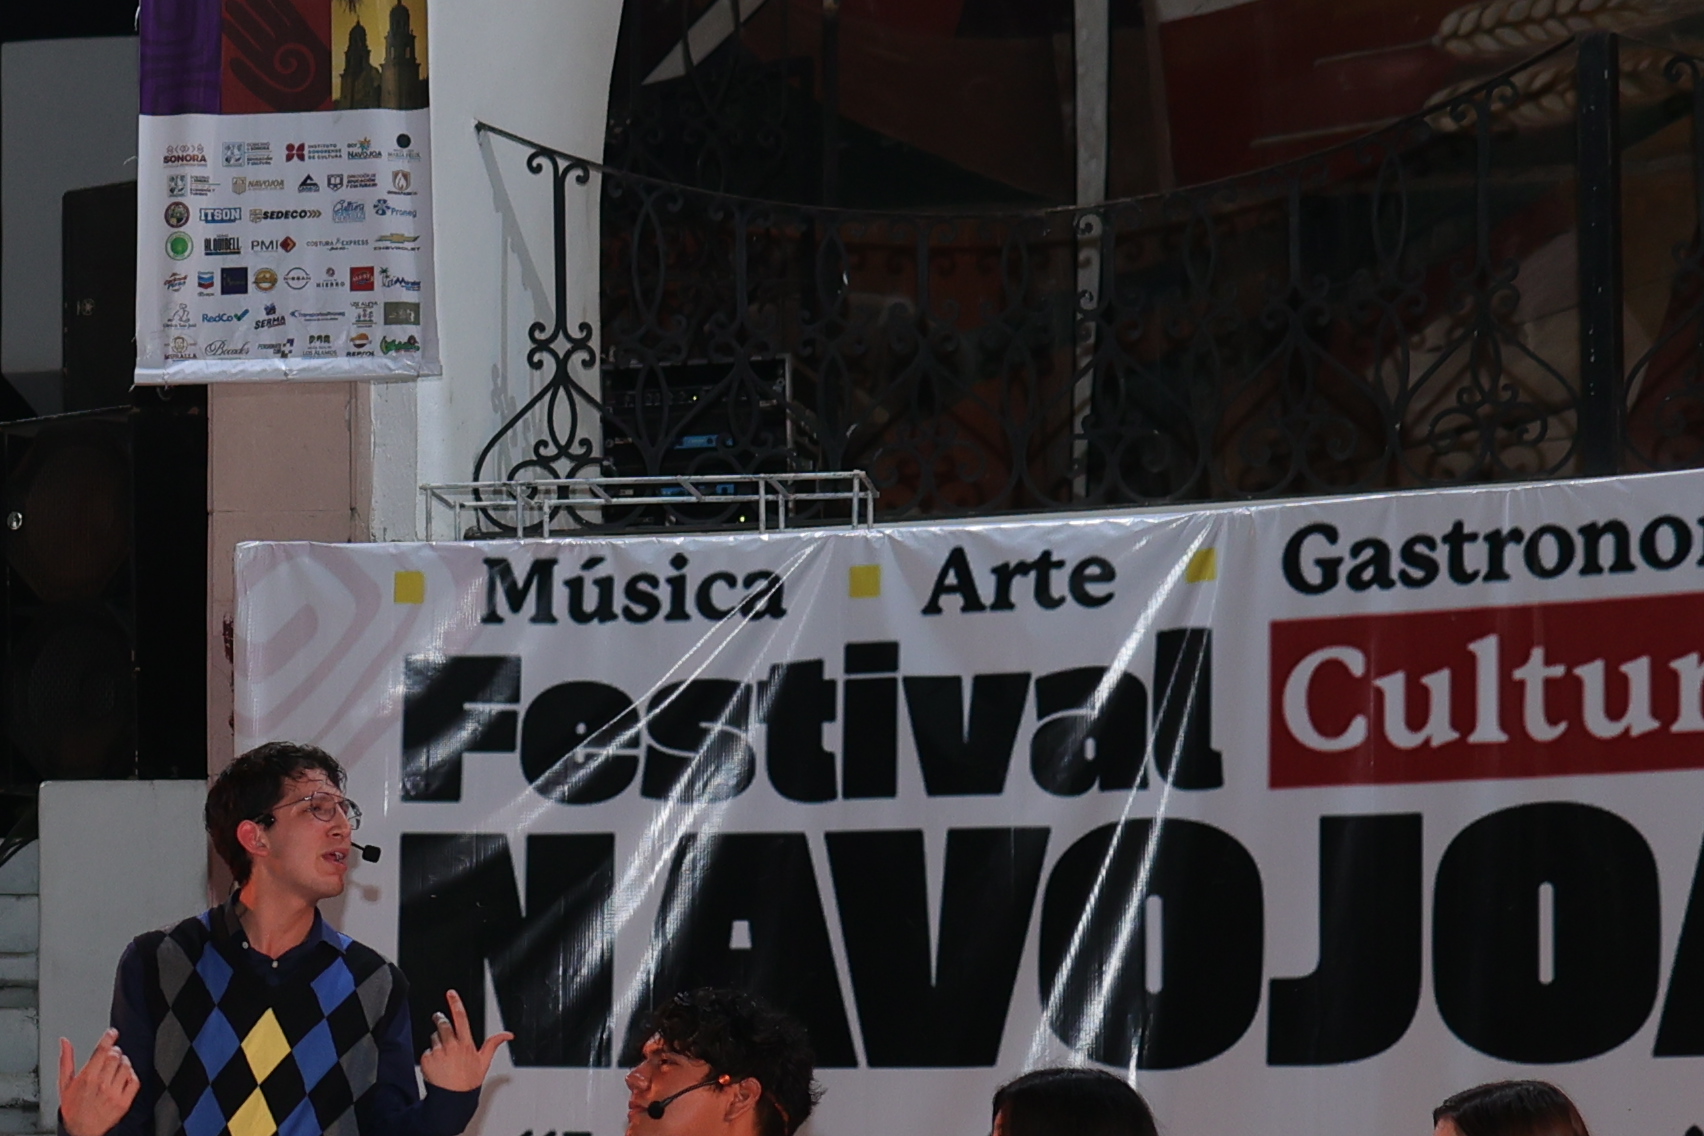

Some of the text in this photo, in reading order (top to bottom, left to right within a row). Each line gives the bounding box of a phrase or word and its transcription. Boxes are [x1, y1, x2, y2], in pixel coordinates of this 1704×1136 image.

[162, 154, 208, 165] SONORA
[347, 151, 383, 159] NAVOJOA
[247, 179, 285, 188] NAVOJOA
[200, 208, 241, 220] ITSON
[262, 210, 308, 220] SEDECO
[251, 240, 278, 250] PMI
[202, 313, 234, 323] RedCo
[254, 316, 287, 330] SERMA
[1282, 512, 1704, 596] Gastrono
[481, 546, 1117, 625] Música Arte
[400, 628, 1224, 806] Festival
